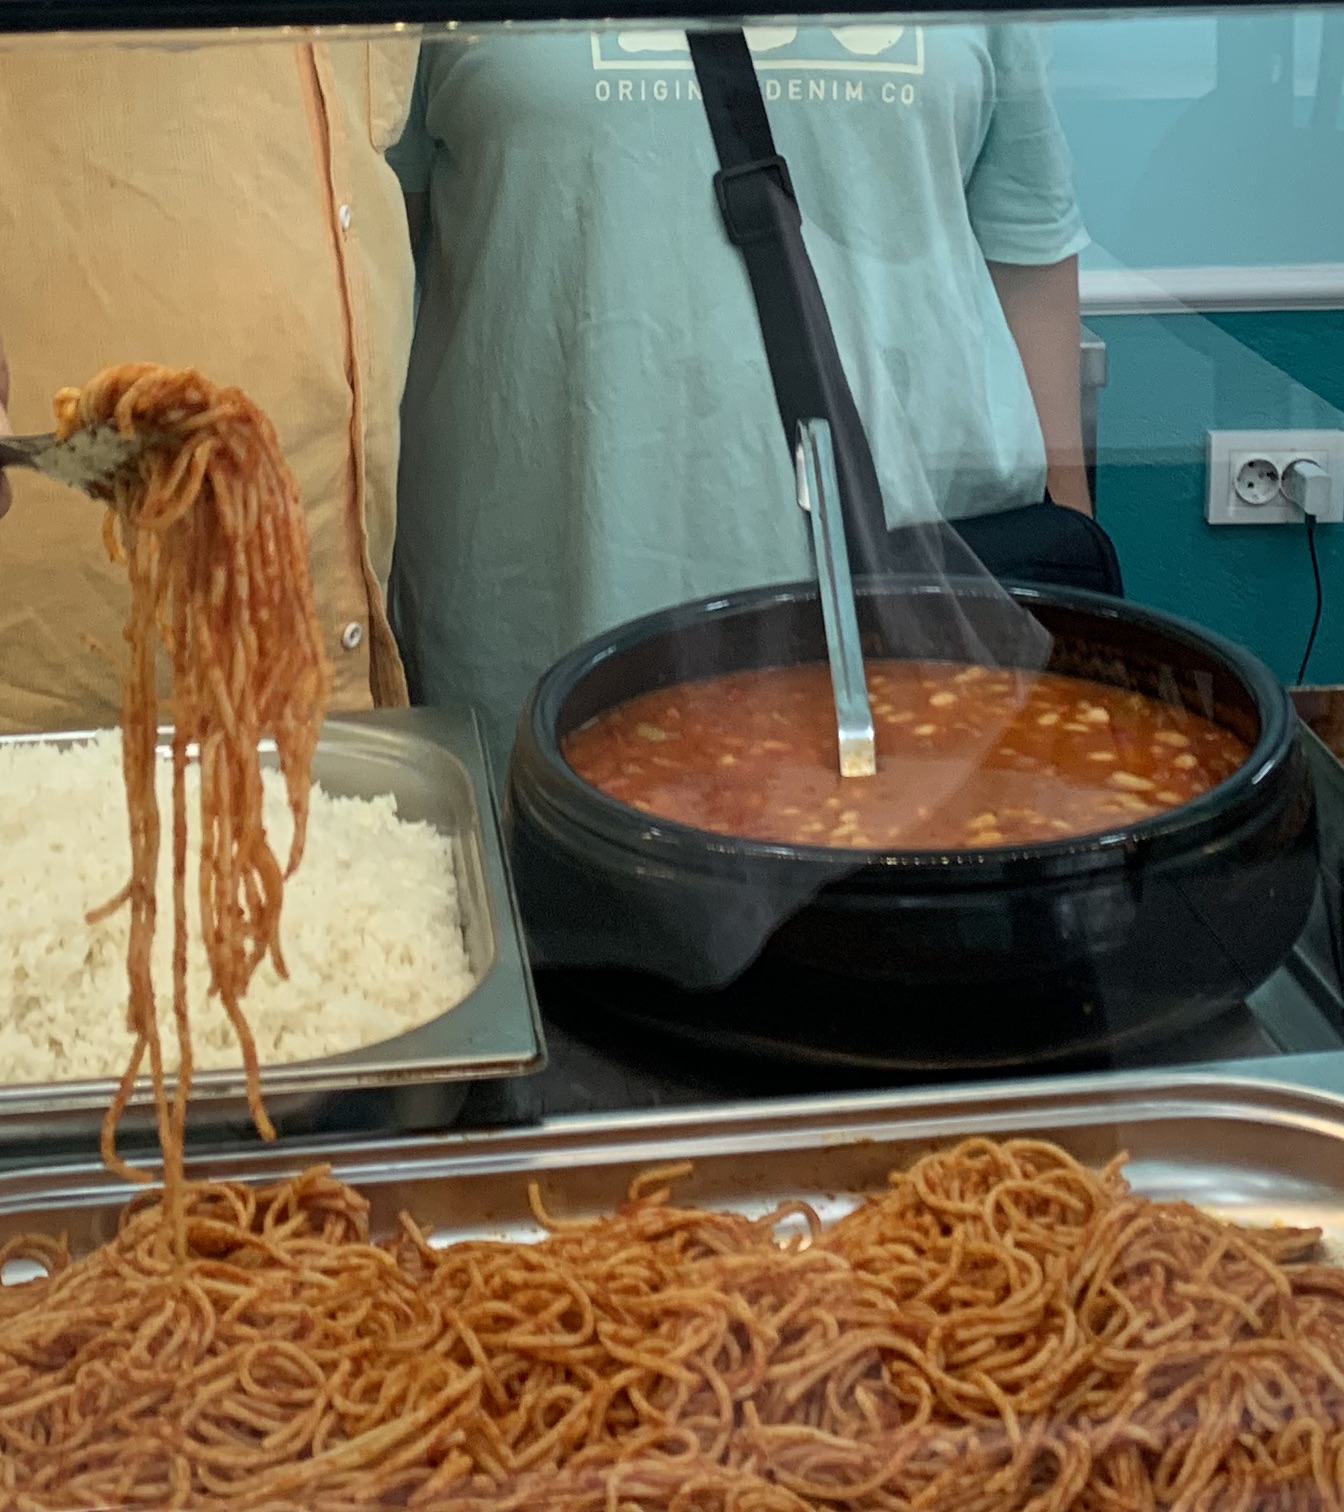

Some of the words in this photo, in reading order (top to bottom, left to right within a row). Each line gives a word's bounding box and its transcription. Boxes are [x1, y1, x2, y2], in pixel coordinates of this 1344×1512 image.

[594, 79, 704, 102] ORIGIN
[765, 78, 864, 102] DENIM
[880, 81, 915, 106] CO
